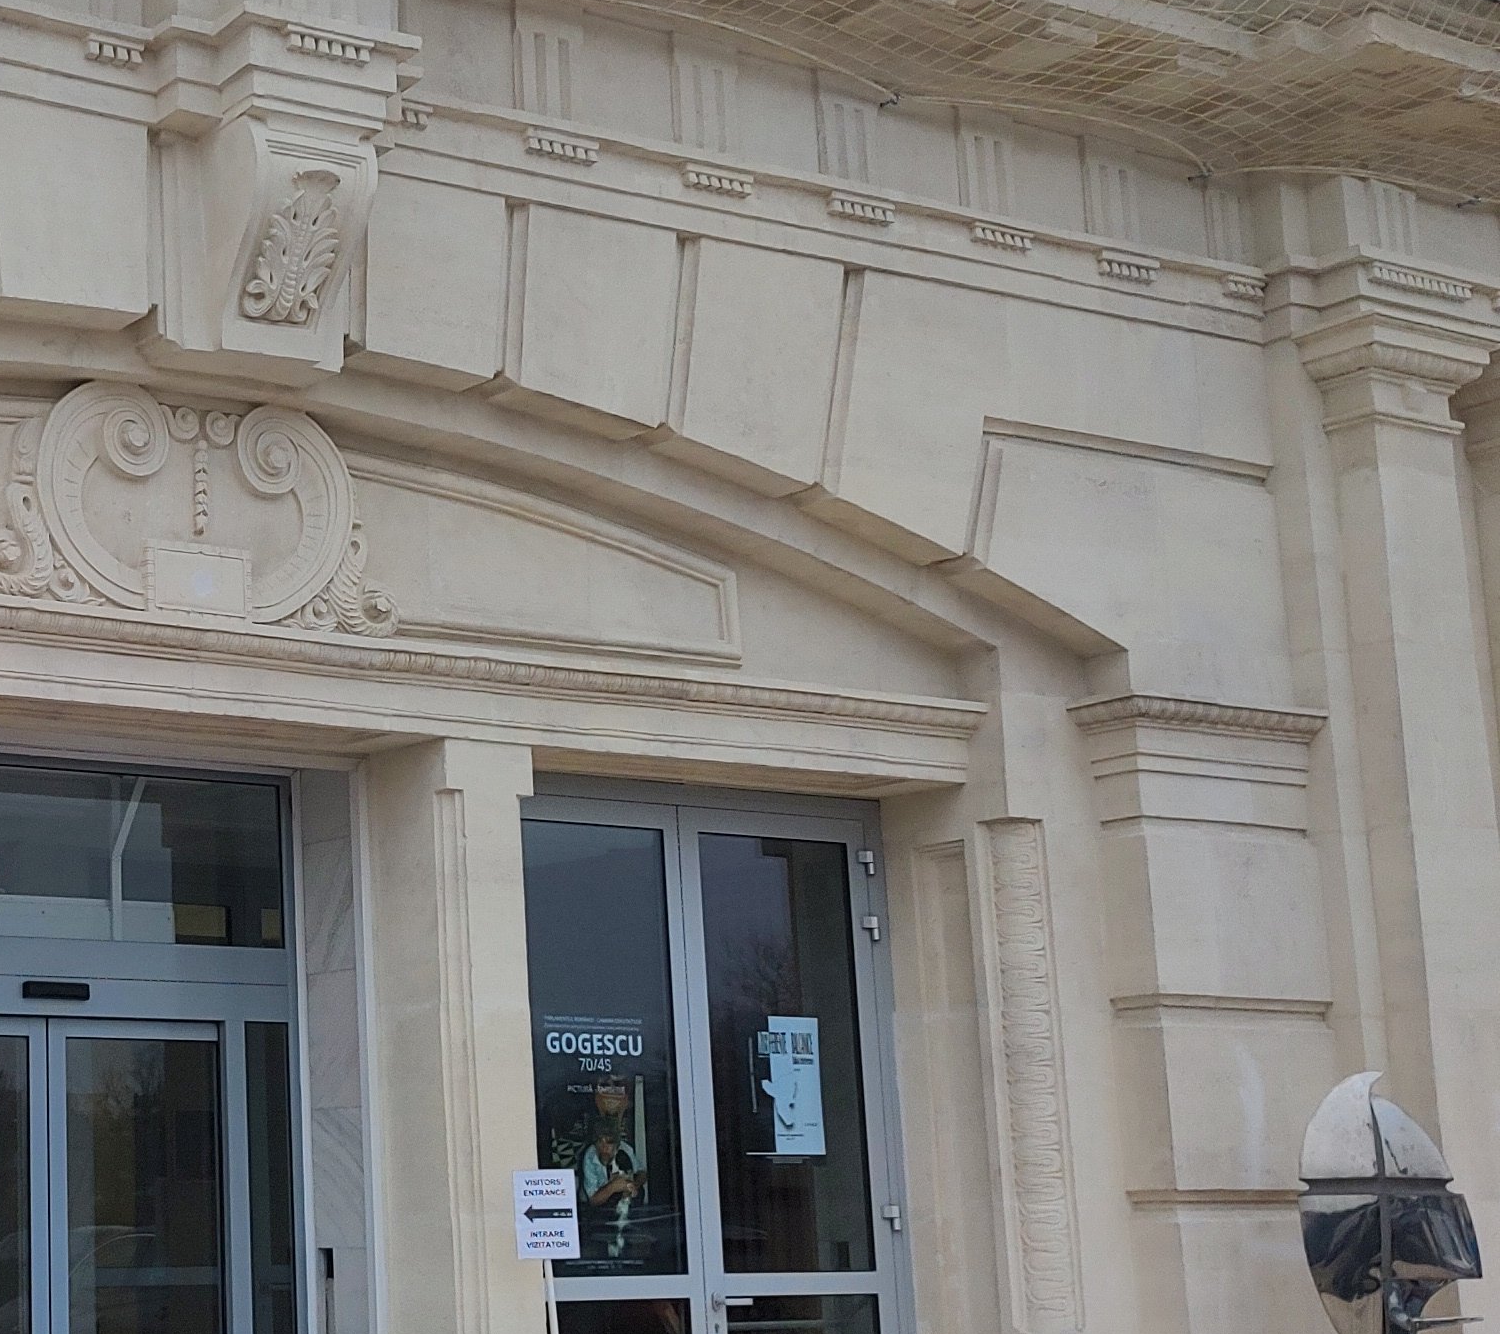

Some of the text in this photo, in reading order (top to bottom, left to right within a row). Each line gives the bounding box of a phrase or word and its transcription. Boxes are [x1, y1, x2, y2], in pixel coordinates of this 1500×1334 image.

[546, 1031, 643, 1056] GOGESCU
[578, 1057, 612, 1072] 70/45
[523, 1189, 566, 1197] ENTRANCE
[530, 1230, 565, 1238] INTRARE
[526, 1241, 570, 1249] VIZITATORI
